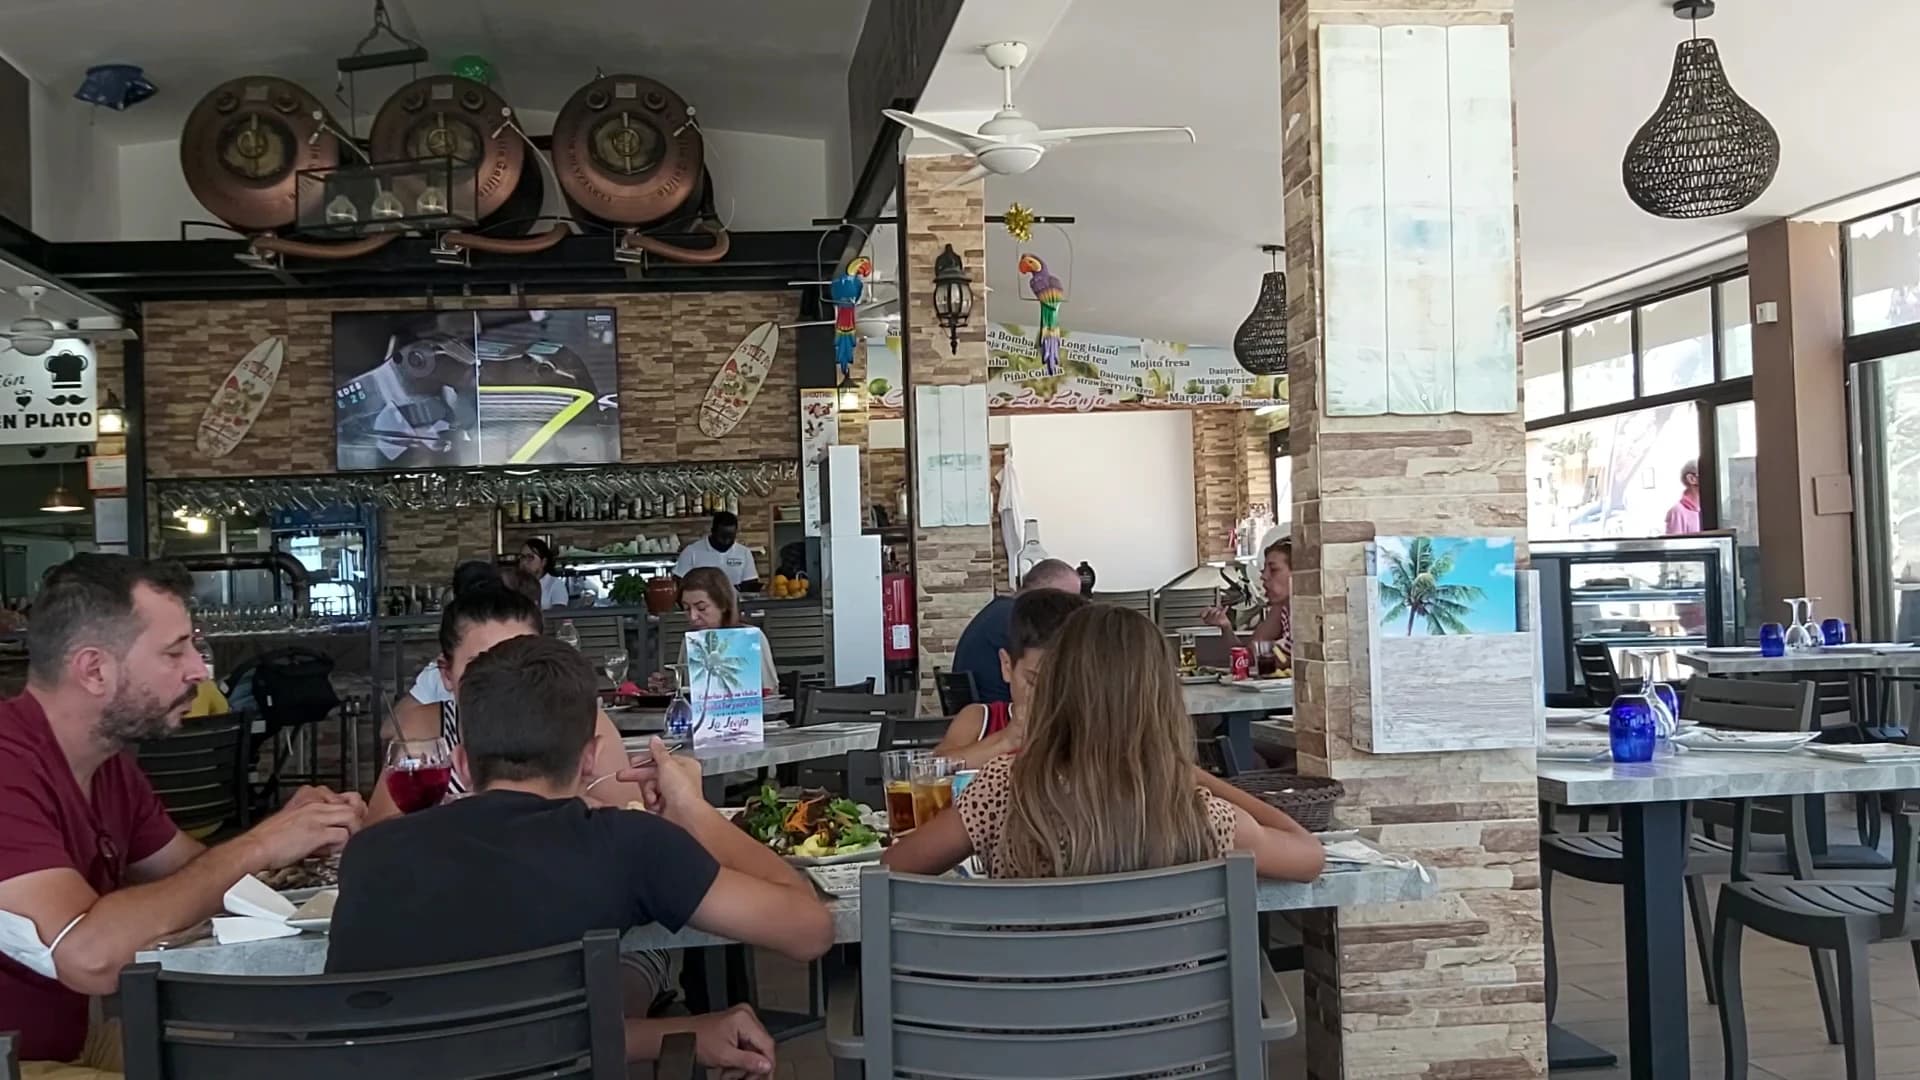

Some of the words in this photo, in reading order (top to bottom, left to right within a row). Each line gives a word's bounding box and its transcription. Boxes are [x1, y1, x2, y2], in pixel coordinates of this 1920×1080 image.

[998, 331, 1034, 347] Bomba
[1061, 340, 1086, 352] Long
[1088, 342, 1119, 356] island
[1069, 352, 1089, 363] iced
[1092, 357, 1108, 366] tea
[1131, 358, 1163, 370] Mojito
[1165, 358, 1190, 368] fresa
[1004, 373, 1026, 383] Piña
[1099, 369, 1136, 383] Daiquiri
[1197, 378, 1226, 387] Mango
[1051, 389, 1105, 412] Lonja
[1169, 393, 1223, 404] Margarita
[25, 412, 92, 429] PLATO
